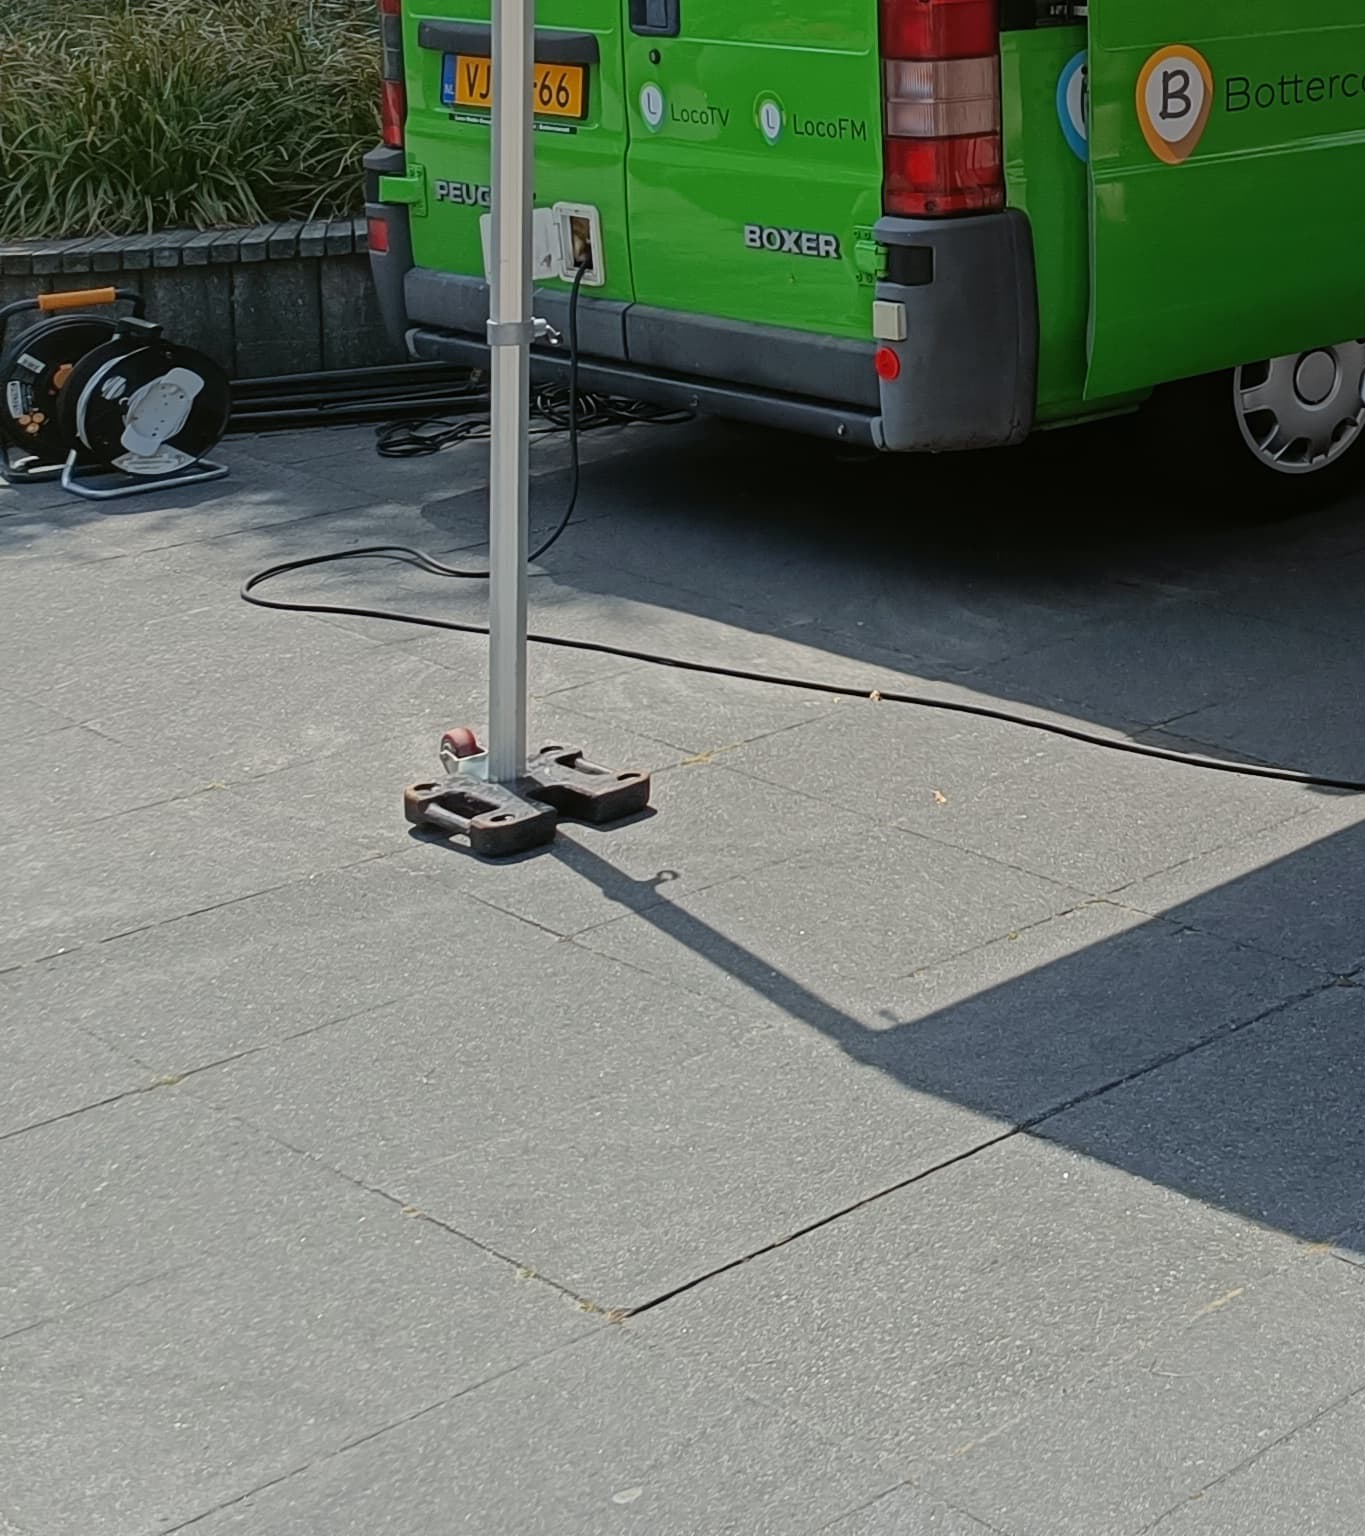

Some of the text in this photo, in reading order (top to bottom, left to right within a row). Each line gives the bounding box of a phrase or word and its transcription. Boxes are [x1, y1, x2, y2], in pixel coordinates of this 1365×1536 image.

[670, 104, 730, 127] LocoTV
[793, 113, 867, 142] LocoFM
[744, 224, 841, 259] BOXER
